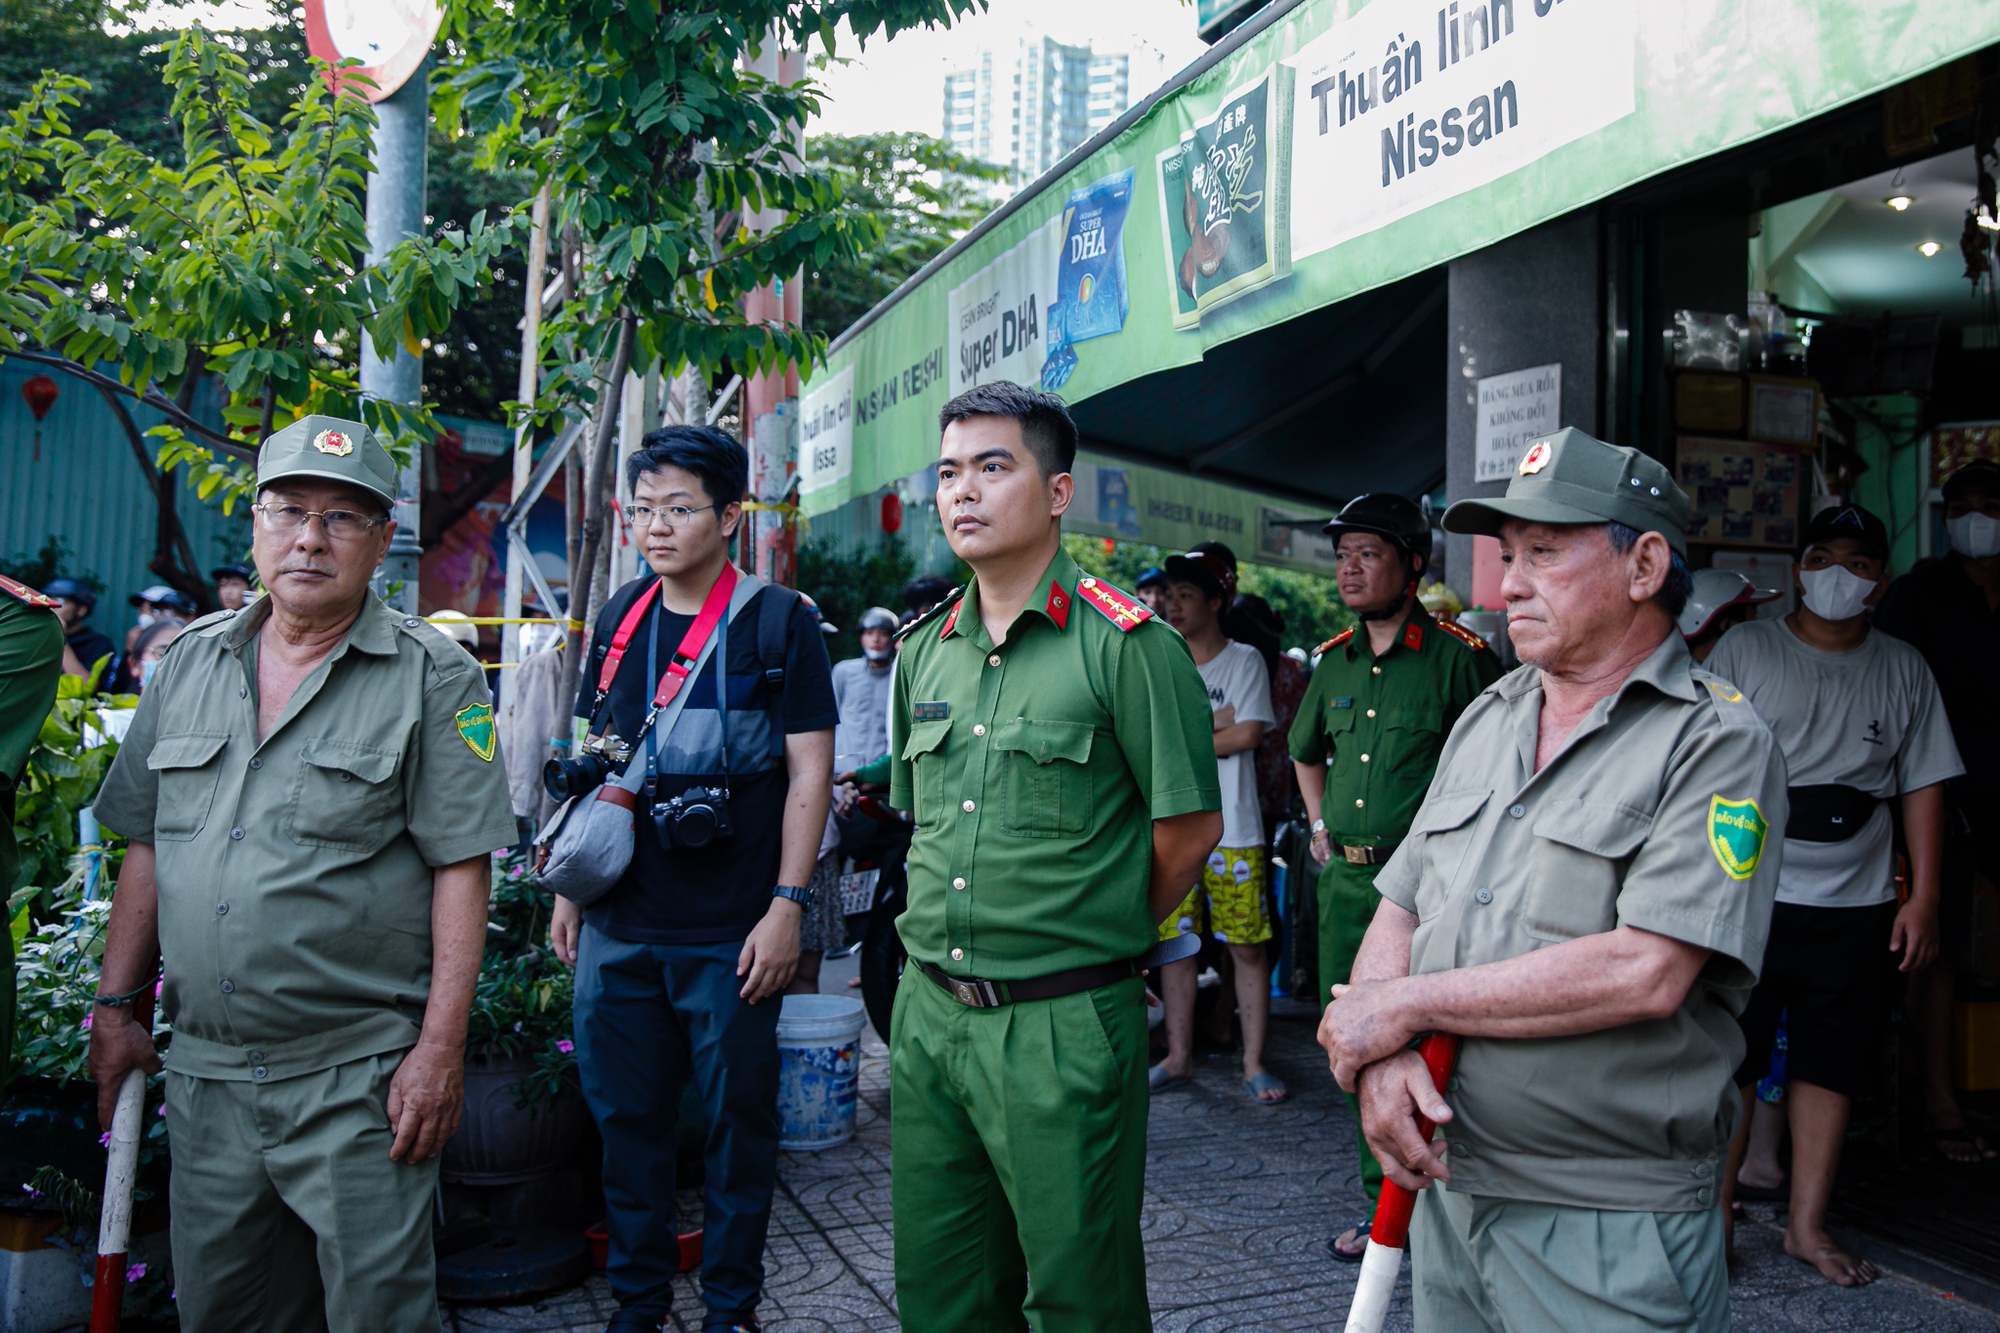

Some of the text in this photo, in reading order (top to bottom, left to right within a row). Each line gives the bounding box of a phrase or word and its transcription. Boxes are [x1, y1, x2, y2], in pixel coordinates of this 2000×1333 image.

[1311, 32, 1422, 136] Thuần
[1381, 80, 1518, 187] Nissan
[1165, 156, 1183, 174] NISS
[1080, 217, 1102, 232] SUPER
[1071, 226, 1107, 265] DHA
[961, 328, 998, 386] Super
[1003, 293, 1038, 358] DHA
[1482, 384, 1509, 404] HÀNG
[1512, 379, 1534, 398] MUA
[1489, 406, 1524, 427] KHÔNG
[1491, 432, 1519, 451] HOẶC
[1715, 810, 1733, 825] BẢO
